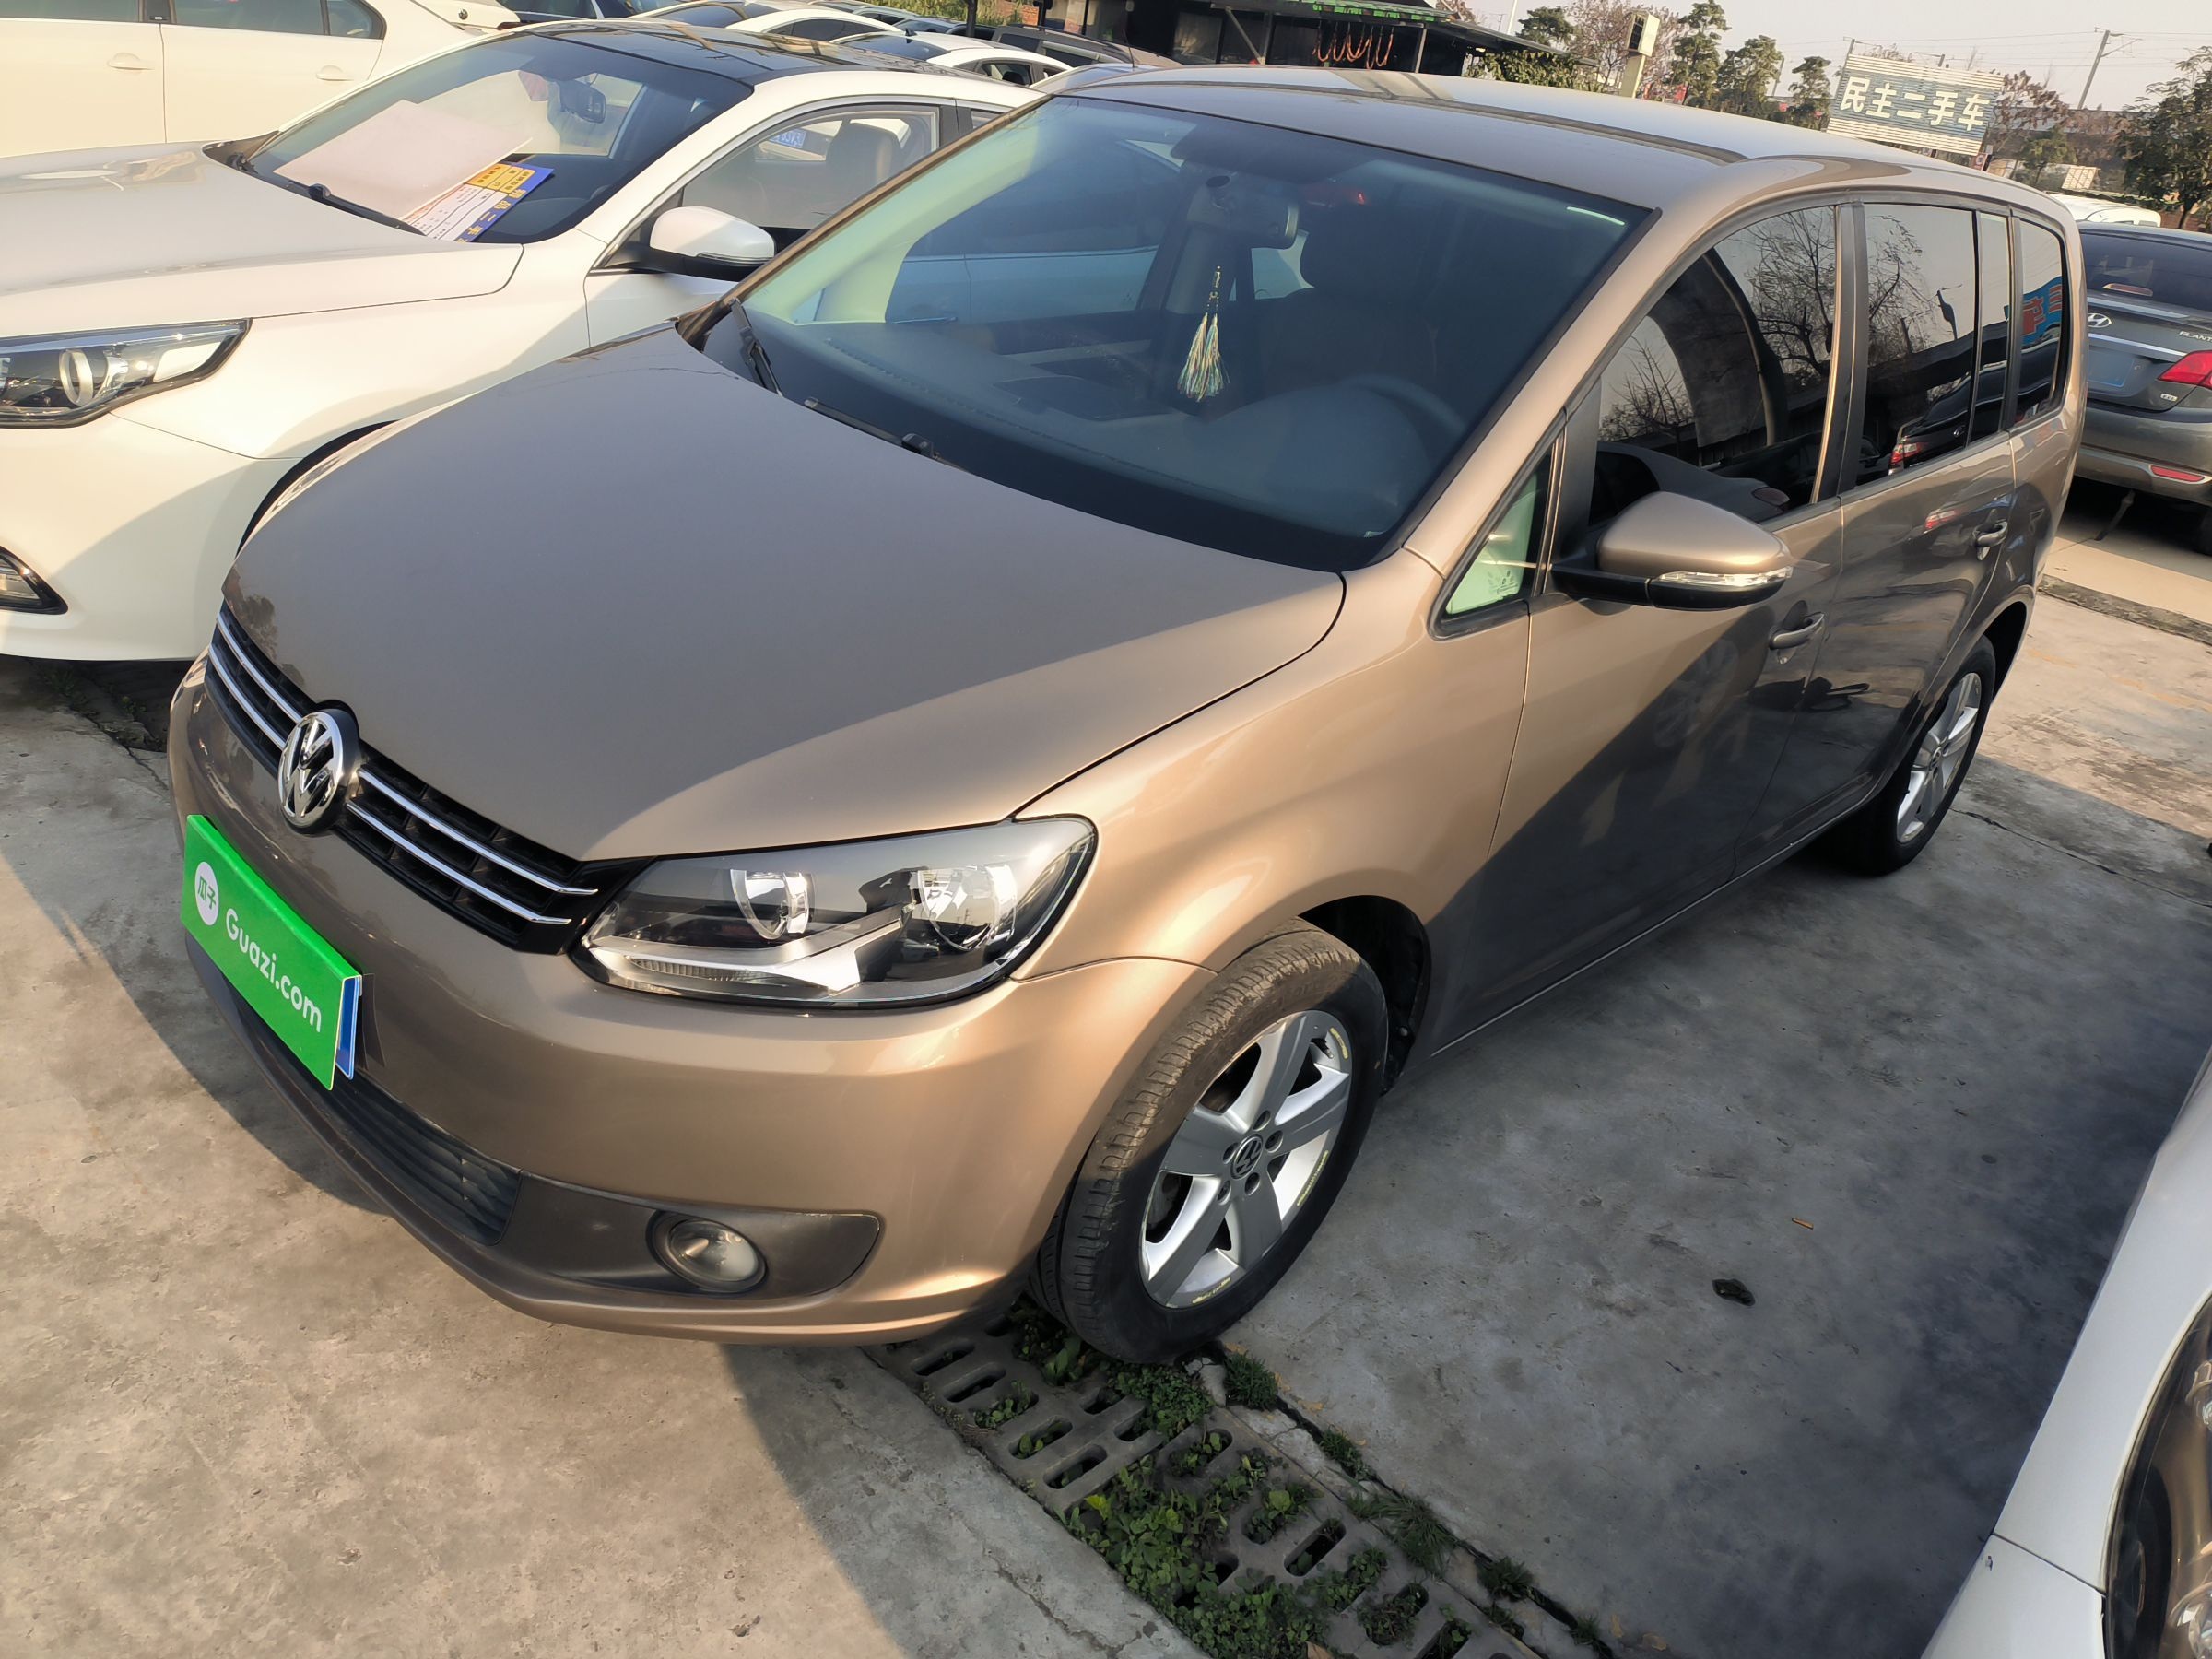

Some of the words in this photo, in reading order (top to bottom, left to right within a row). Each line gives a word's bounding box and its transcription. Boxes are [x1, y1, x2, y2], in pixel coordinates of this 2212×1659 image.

[1840, 76, 1990, 132] 民主二手车
[196, 876, 217, 911] 瓜子
[225, 908, 323, 1033] Guazi.com
